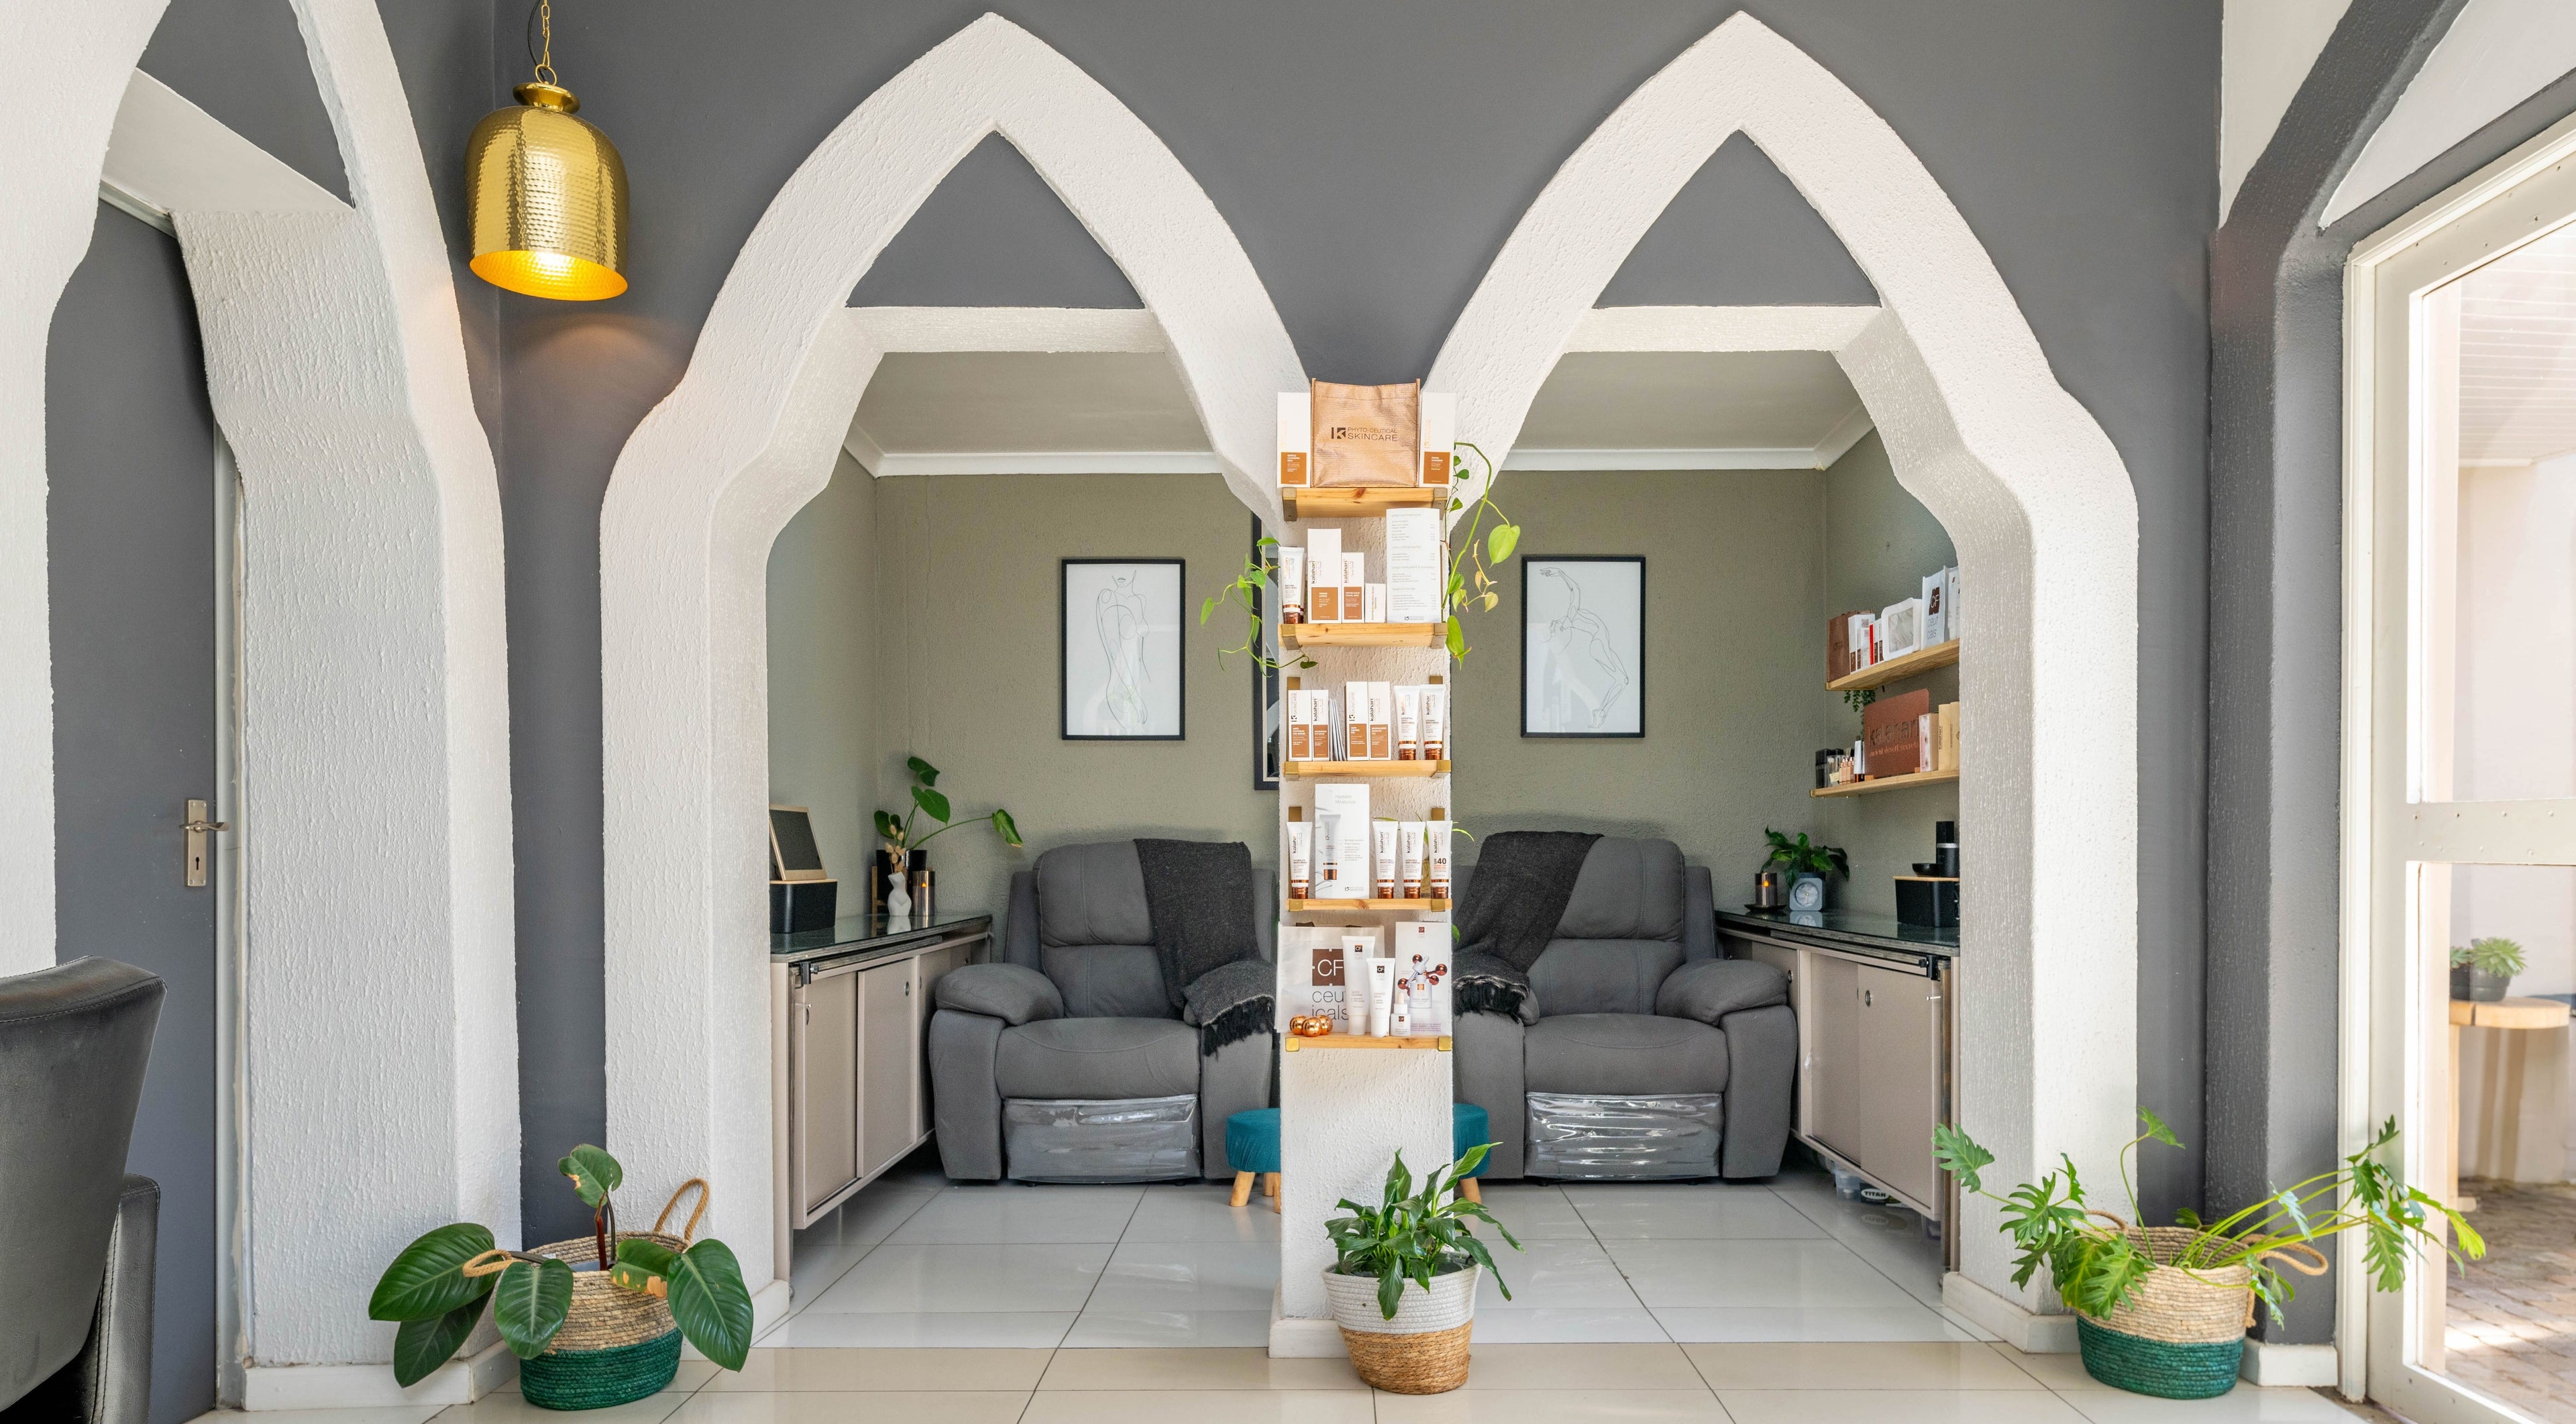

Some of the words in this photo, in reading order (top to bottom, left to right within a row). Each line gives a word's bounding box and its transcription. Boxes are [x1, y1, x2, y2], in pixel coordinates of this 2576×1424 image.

[1348, 433, 1398, 441] SKINCARE
[1931, 594, 1939, 608] CF
[1318, 959, 1344, 977] CF
[1312, 991, 1346, 1003] ceu
